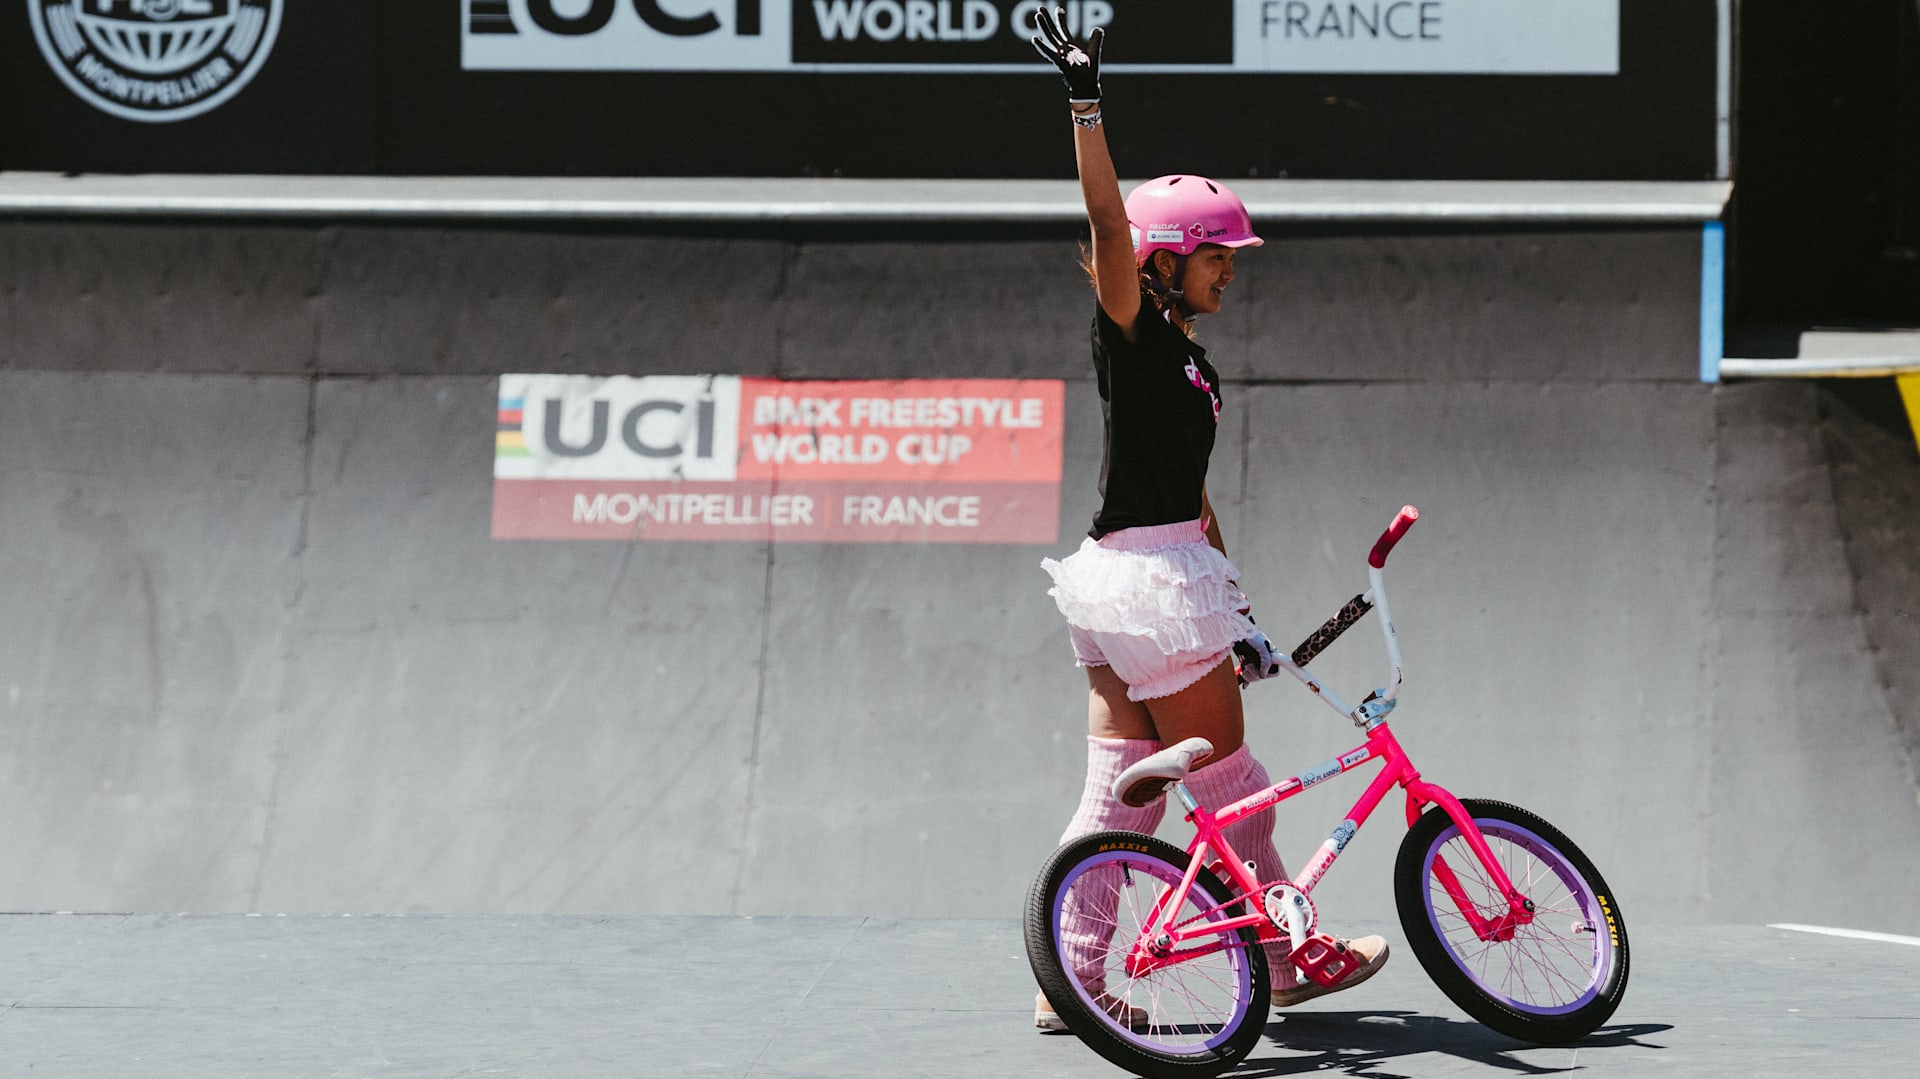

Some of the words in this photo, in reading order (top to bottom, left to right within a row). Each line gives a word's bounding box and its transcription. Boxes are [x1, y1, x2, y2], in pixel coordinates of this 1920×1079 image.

[814, 0, 1000, 41] WORLD
[1260, 0, 1443, 40] FRANCE
[75, 54, 234, 105] MONTPELLIER
[543, 399, 714, 458] UCI
[753, 397, 841, 428] BMX
[848, 397, 1043, 428] FREESTYLE
[752, 434, 886, 465] WORLD
[896, 434, 972, 465] CUP
[572, 493, 814, 525] MONTPELLIER
[842, 495, 980, 526] FRANCE
[1099, 843, 1149, 852] MAXXIS
[1597, 895, 1619, 947] MAXXIS
